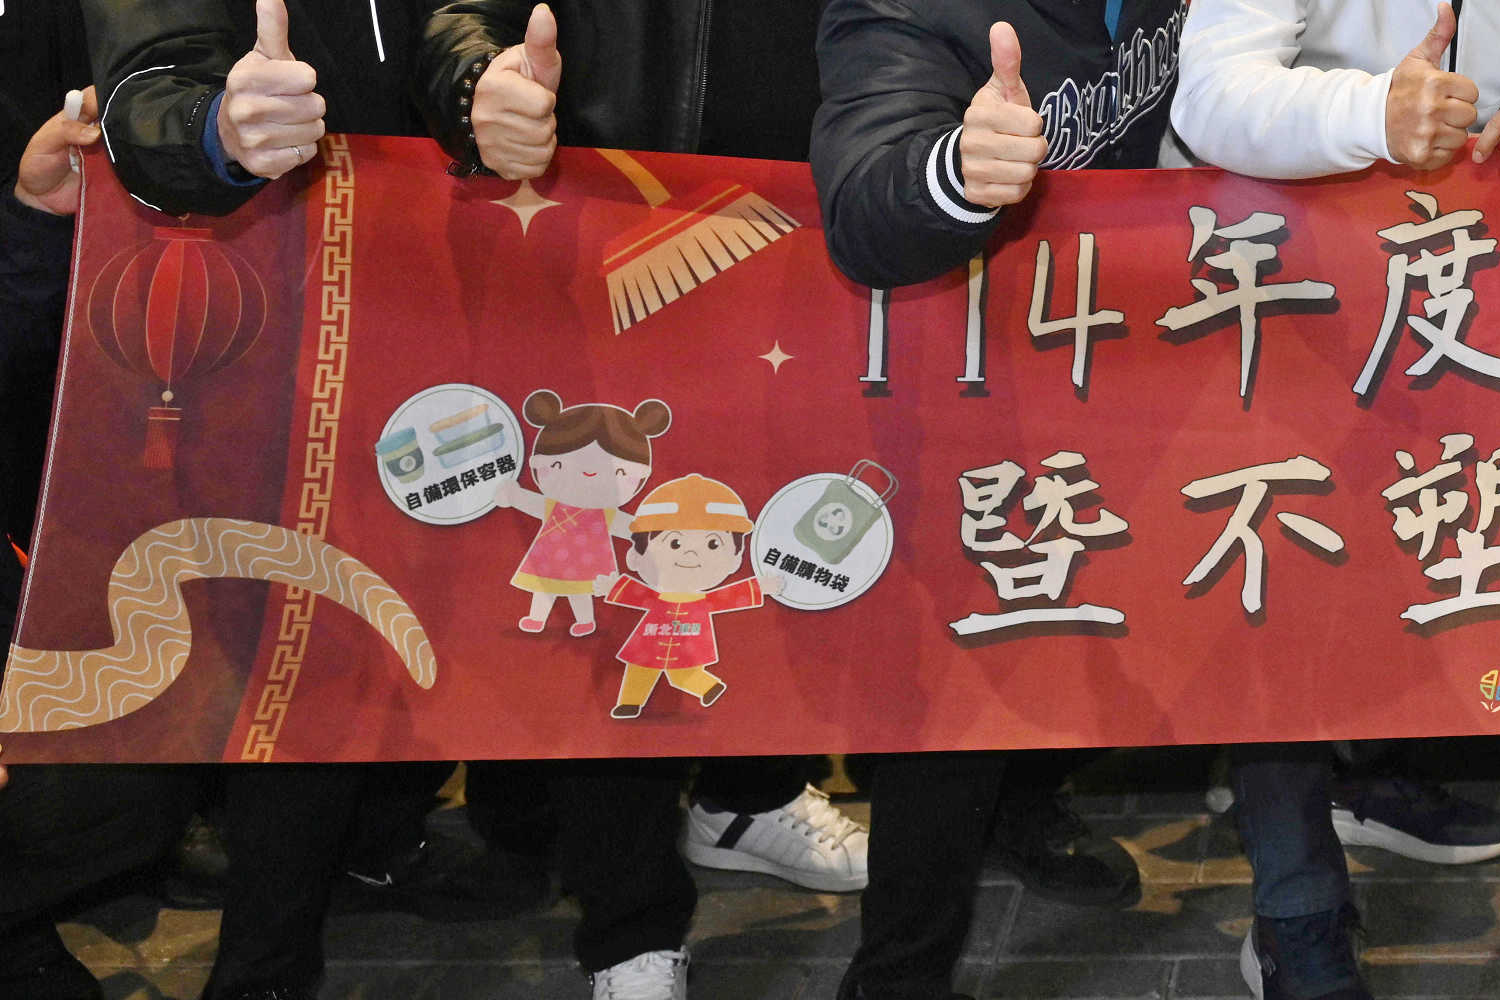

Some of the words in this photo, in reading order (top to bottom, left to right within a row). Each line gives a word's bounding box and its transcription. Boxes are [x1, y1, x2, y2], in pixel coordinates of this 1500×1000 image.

[405, 453, 518, 512] 自備環保容器
[763, 547, 851, 593] 自備購物袋
